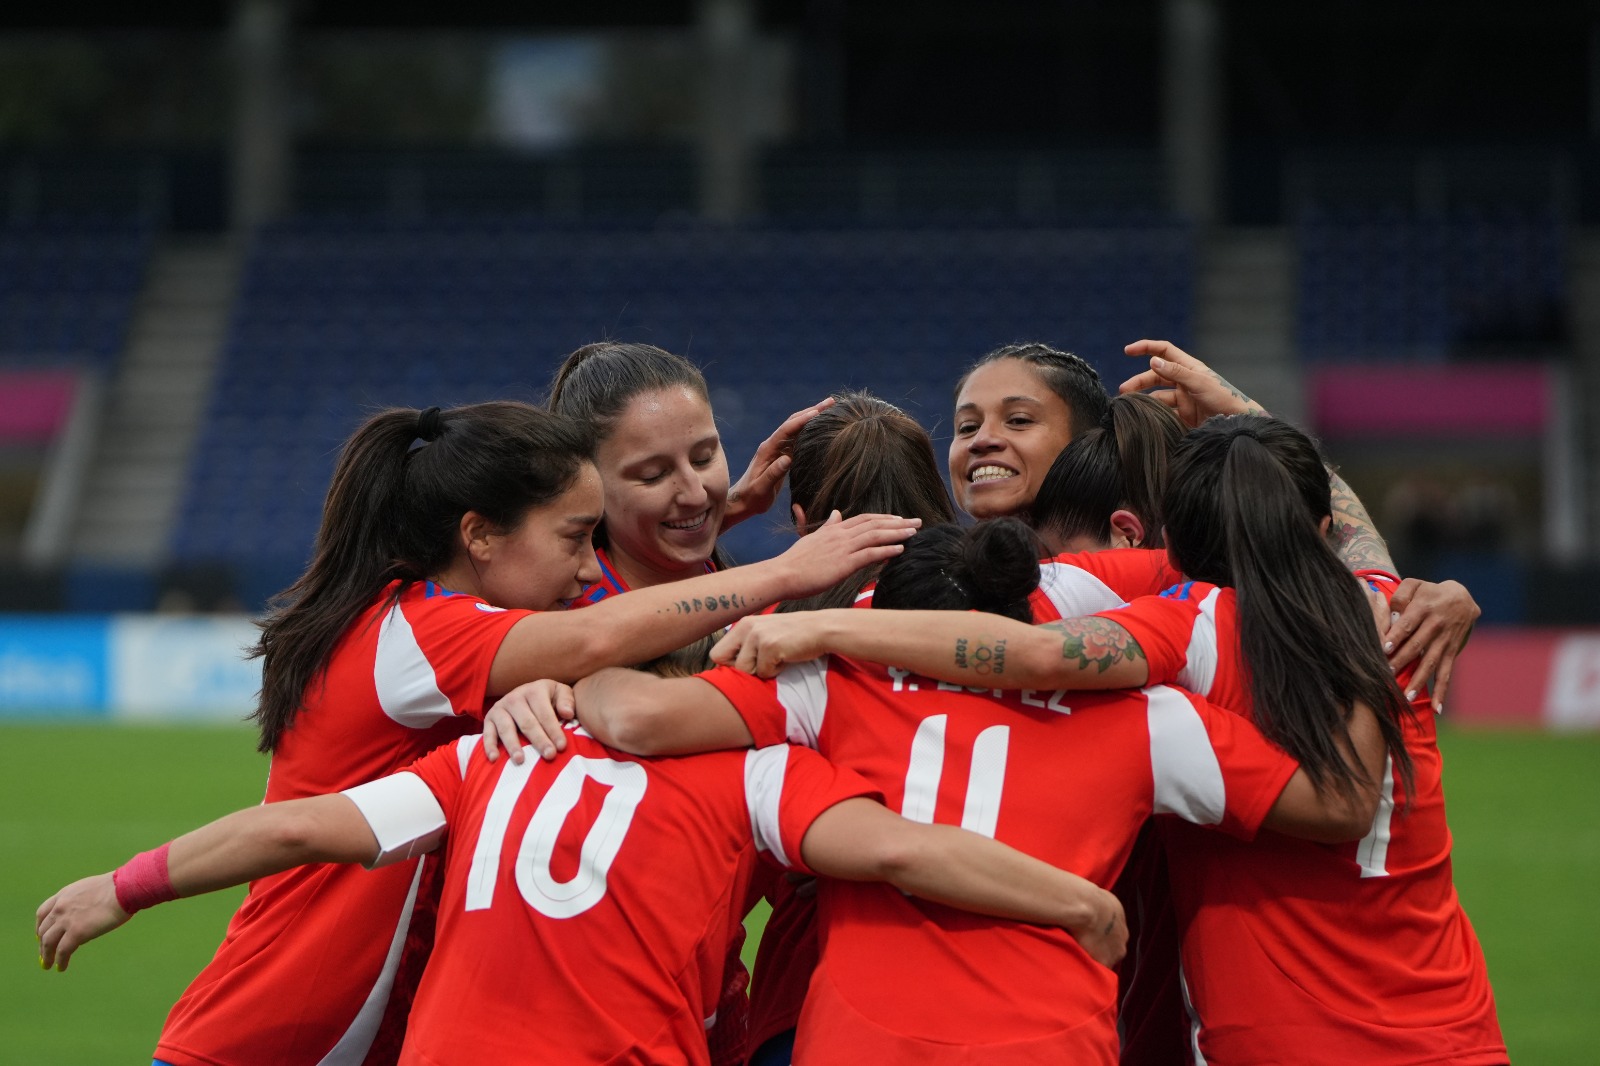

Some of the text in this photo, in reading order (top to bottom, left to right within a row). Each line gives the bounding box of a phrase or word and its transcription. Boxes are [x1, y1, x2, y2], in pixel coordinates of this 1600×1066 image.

[993, 639, 1006, 674] TOKYO
[464, 744, 648, 919] 10
[901, 713, 1010, 839] 11
